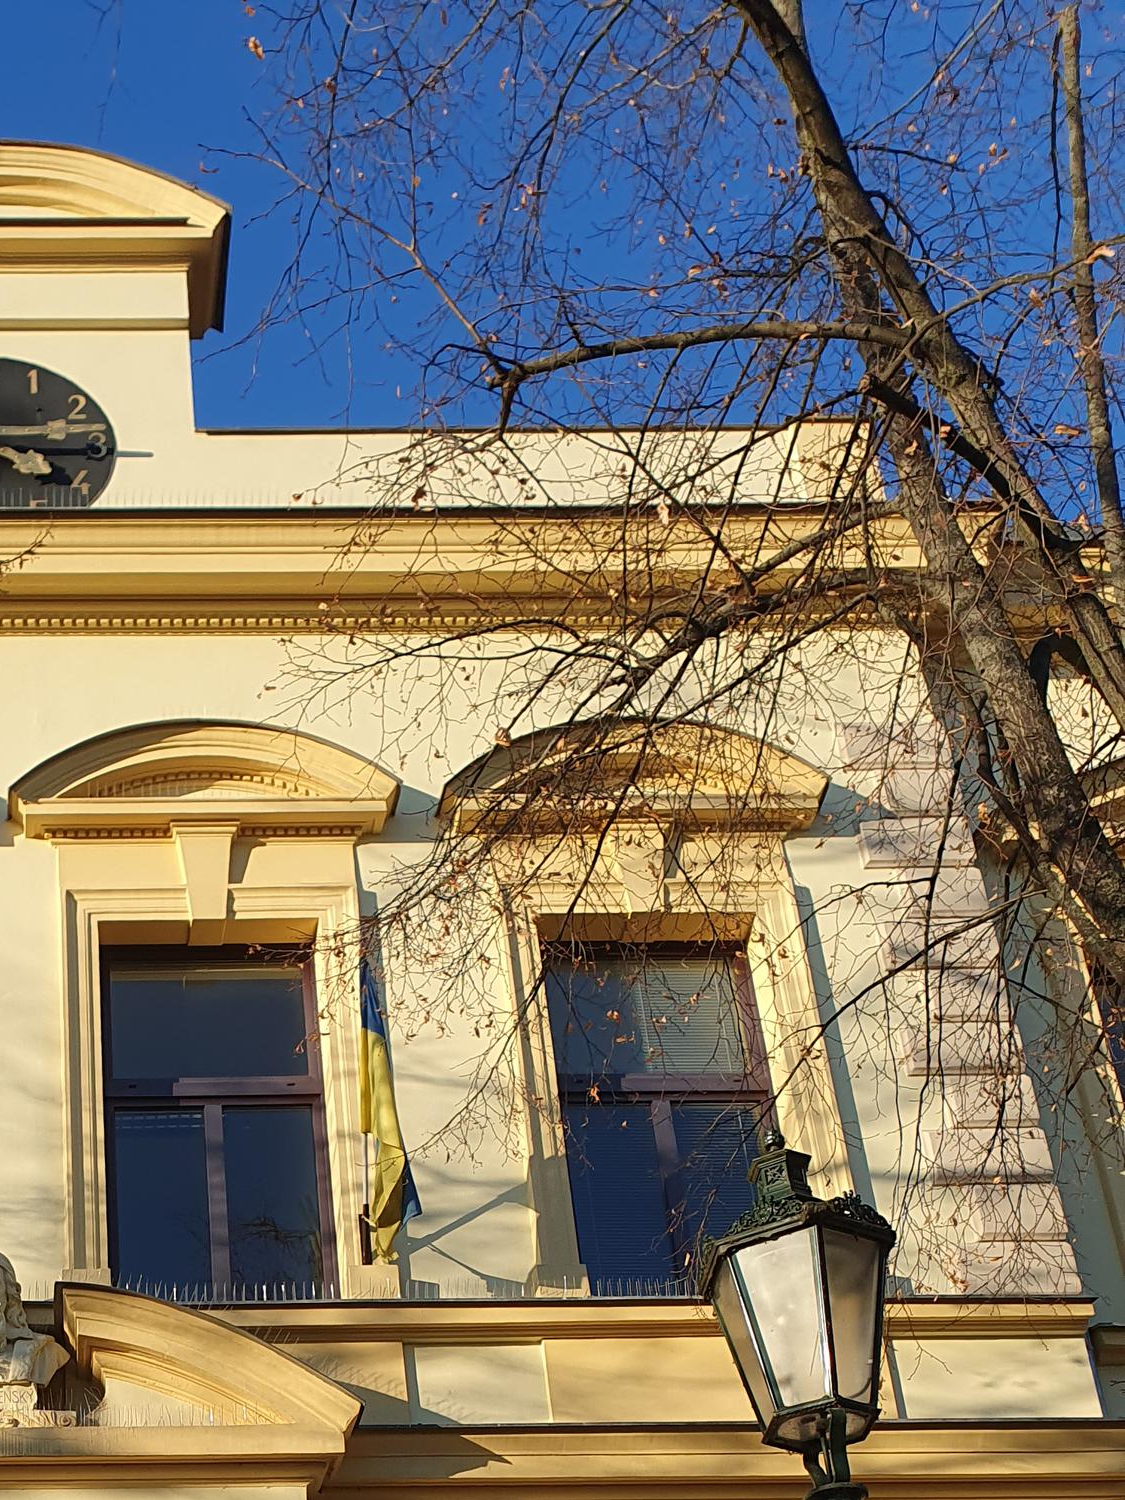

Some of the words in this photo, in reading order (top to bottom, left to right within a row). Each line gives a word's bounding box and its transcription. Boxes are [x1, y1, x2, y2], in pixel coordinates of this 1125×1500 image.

[27, 369, 38, 395] 1
[67, 394, 87, 420] 2
[87, 432, 107, 459] 3
[70, 469, 91, 495] 4
